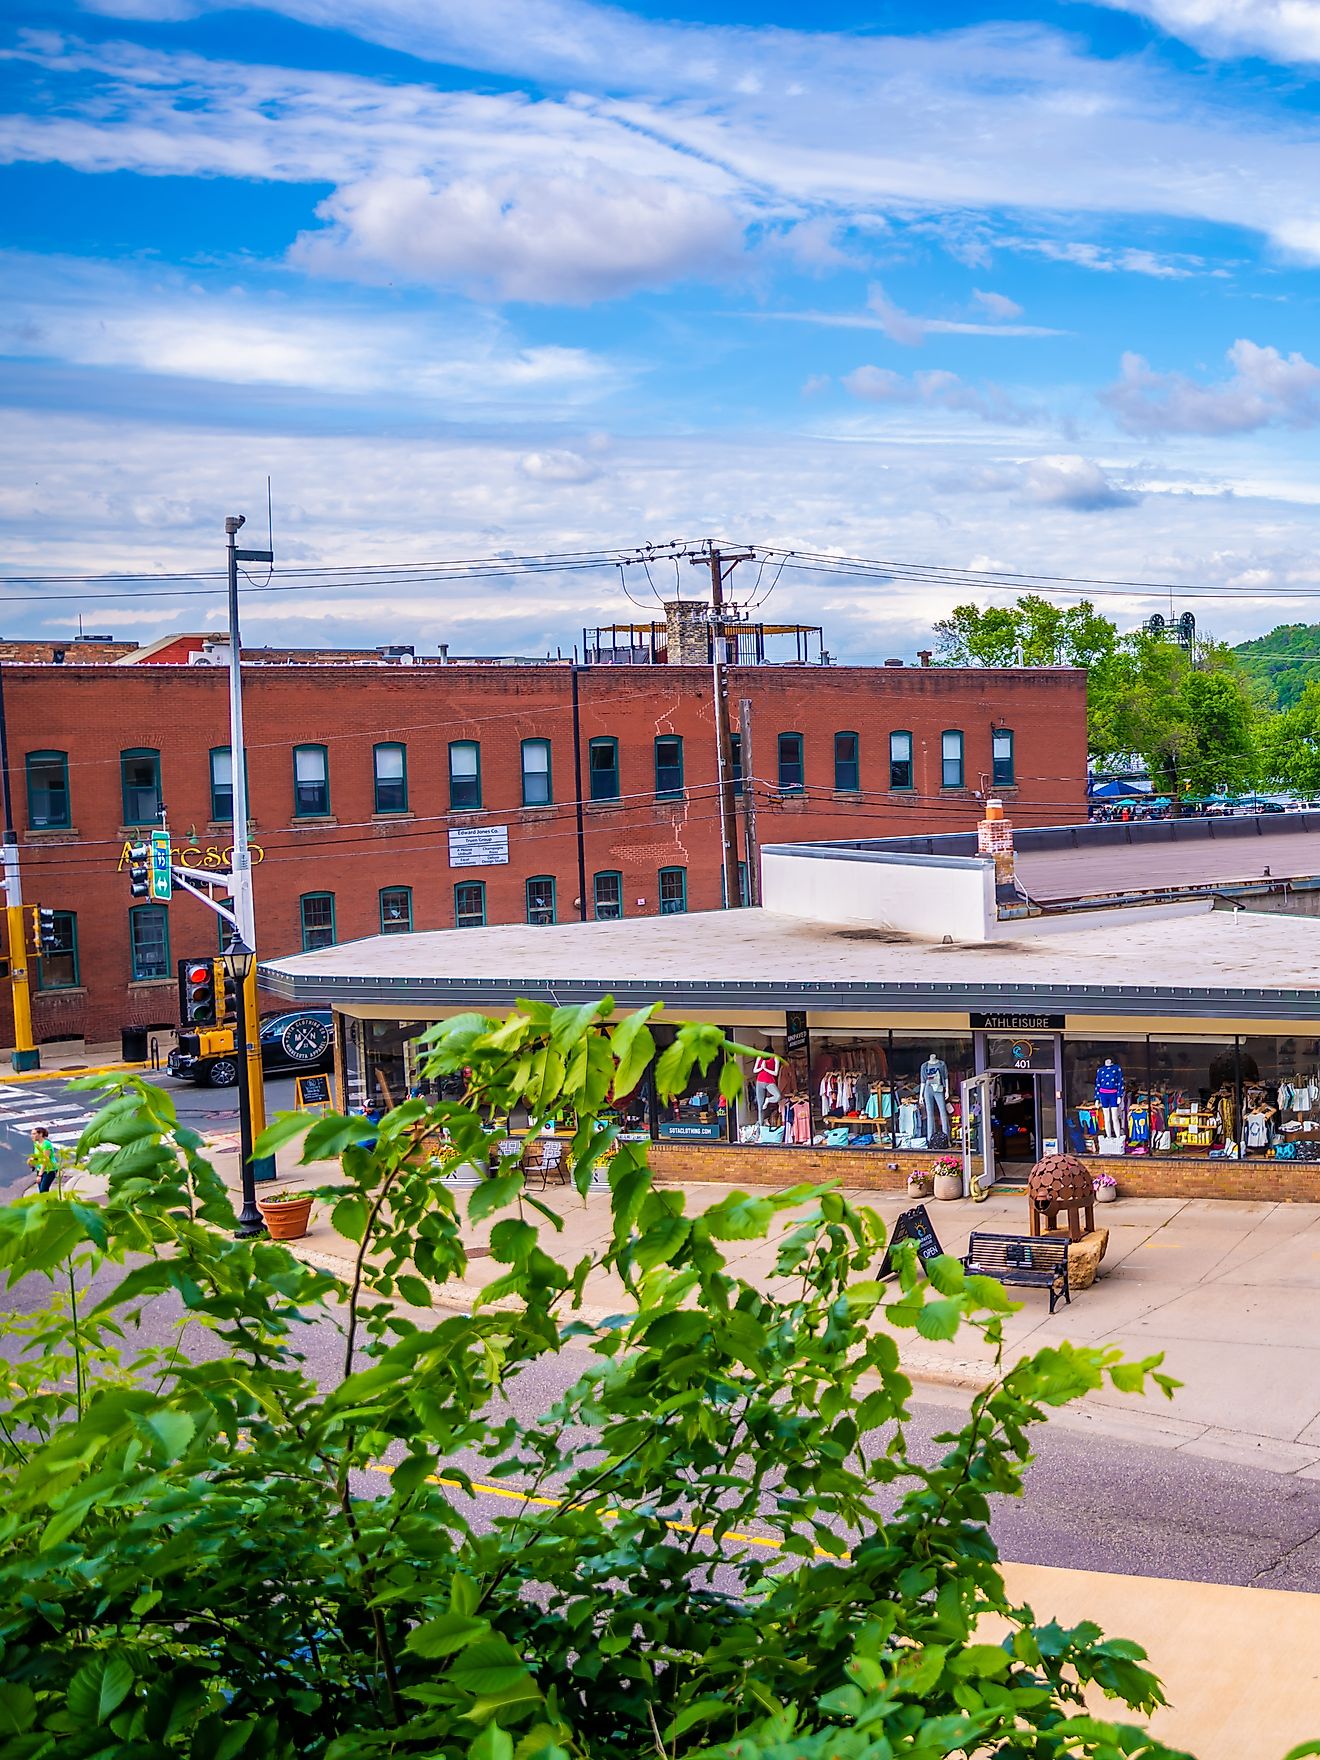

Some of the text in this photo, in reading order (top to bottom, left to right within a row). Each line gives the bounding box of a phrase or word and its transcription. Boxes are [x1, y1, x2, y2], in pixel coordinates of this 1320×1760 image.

[984, 1017, 1050, 1029] ATHLEISURE
[1014, 1060, 1031, 1069] 401
[669, 1127, 712, 1135] SOTACLOTHING.COM
[923, 1245, 939, 1258] OPEN
